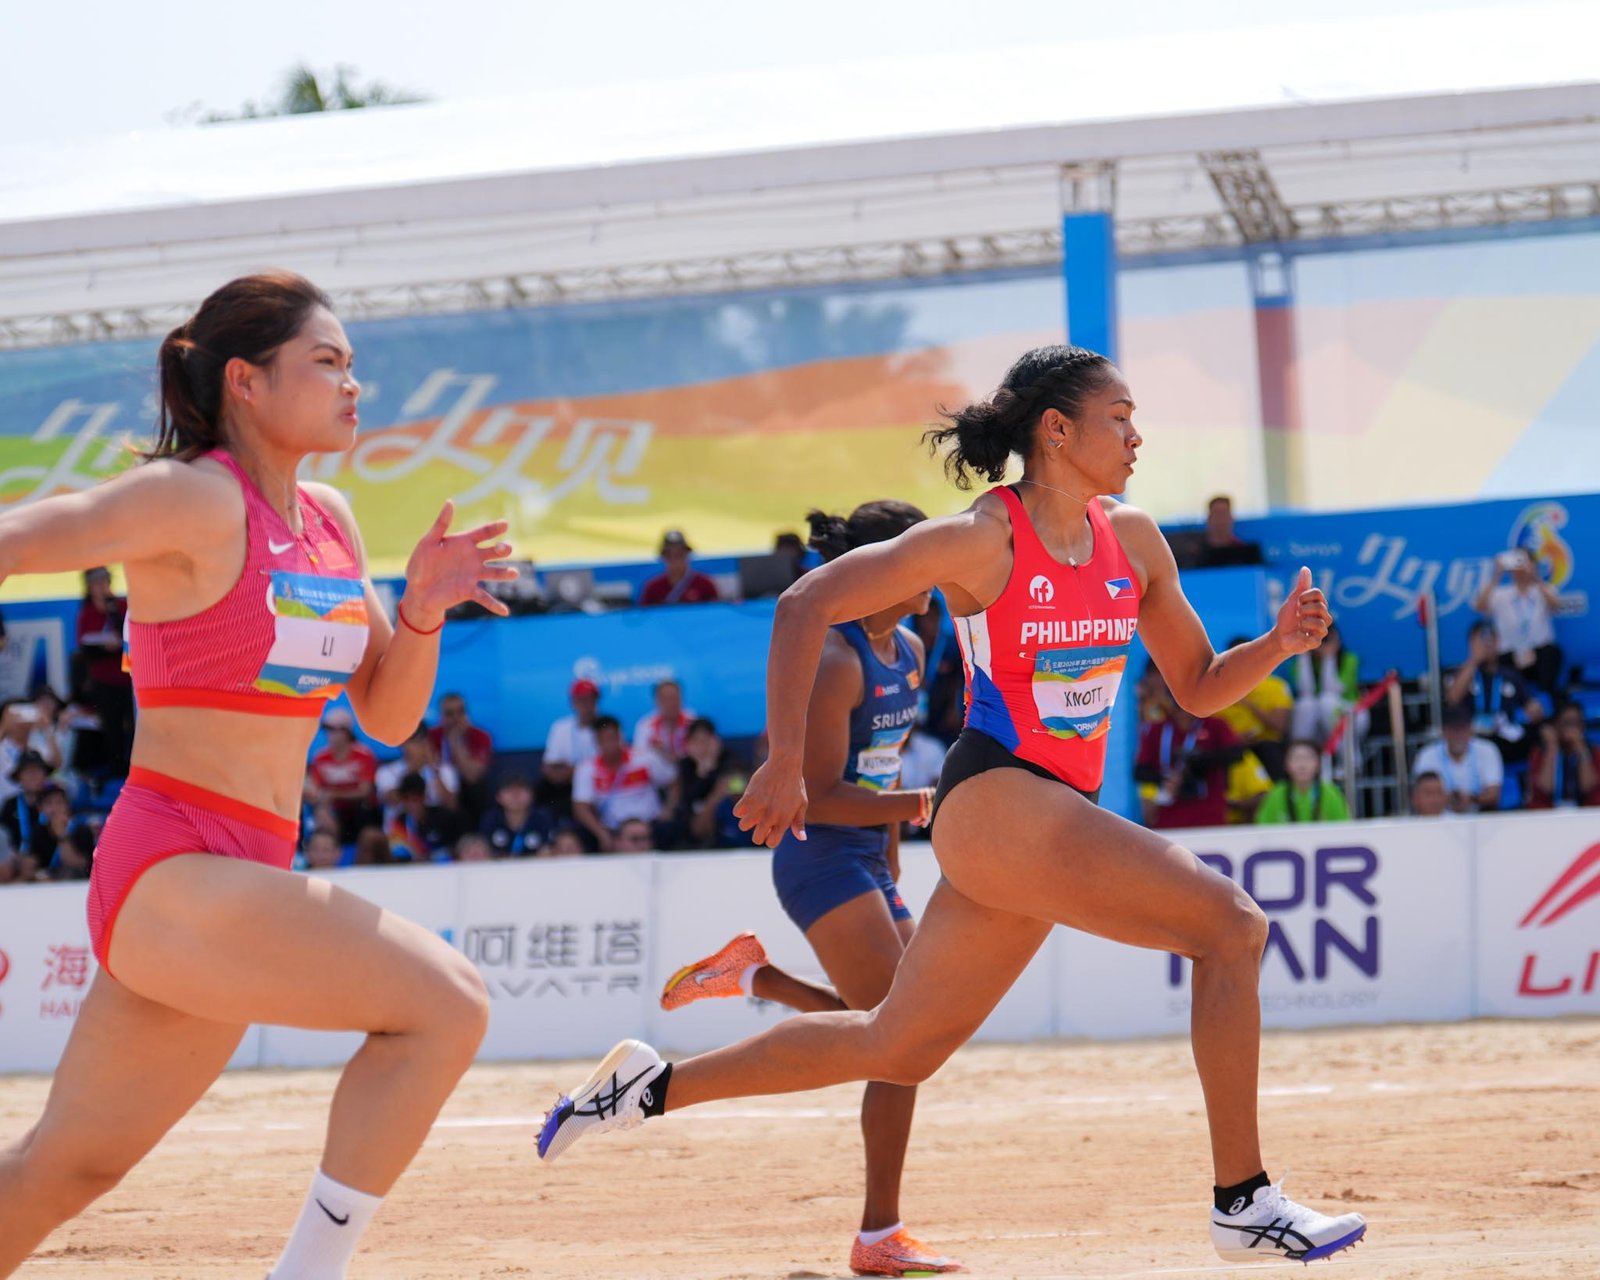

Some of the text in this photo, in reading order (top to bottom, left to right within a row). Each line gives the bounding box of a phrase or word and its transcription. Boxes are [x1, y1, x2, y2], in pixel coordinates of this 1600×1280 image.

[321, 636, 335, 657] LI
[1064, 687, 1103, 708] KNOTT
[871, 712, 895, 730] SRI
[1197, 846, 1379, 910] OR
[465, 921, 642, 969] 阿维塔
[1167, 915, 1379, 988] AN
